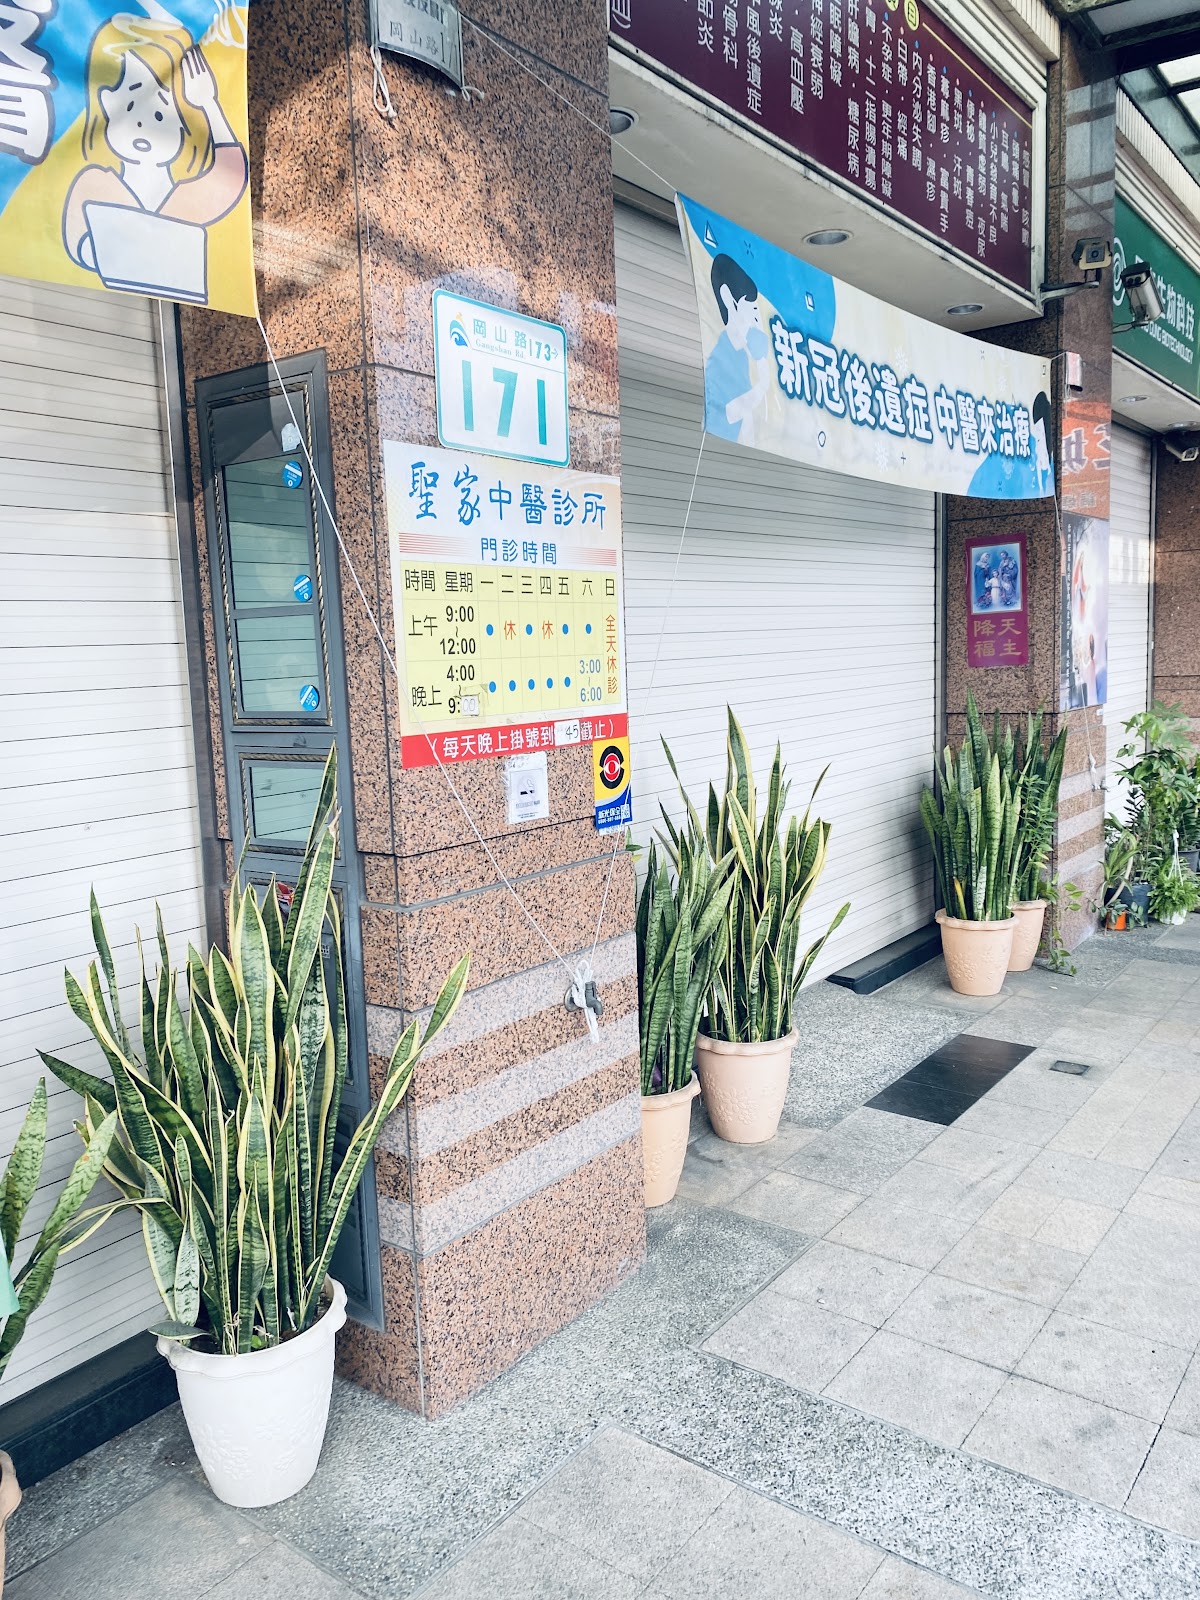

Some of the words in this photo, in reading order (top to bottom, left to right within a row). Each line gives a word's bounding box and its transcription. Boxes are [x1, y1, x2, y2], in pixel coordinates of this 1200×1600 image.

[723, 0, 738, 69] 骨科
[829, 0, 841, 87] 眠障礙
[747, 0, 761, 115] 風後遺症
[473, 318, 528, 349] 岡山路
[475, 339, 512, 357] Gangshan
[770, 315, 933, 443] 新冠後遺症
[934, 384, 1032, 458] 中醫來治療
[461, 359, 548, 446] 171
[409, 461, 607, 530] 聖家中醫診所
[481, 537, 557, 565] 門診時間
[405, 569, 436, 593] 時間
[444, 571, 474, 594] 星期
[540, 576, 552, 595] 四
[558, 577, 570, 596] 五
[581, 578, 593, 596] 六
[605, 578, 615, 597] 日
[408, 615, 438, 637] 上午
[503, 620, 516, 640] 休
[542, 620, 554, 640] 休
[446, 605, 474, 623] 9:00
[440, 638, 476, 655] 12:00
[446, 664, 475, 681] 4:00
[579, 659, 601, 674] 3:00
[411, 686, 442, 708] 晚上
[580, 687, 602, 702] 6:00
